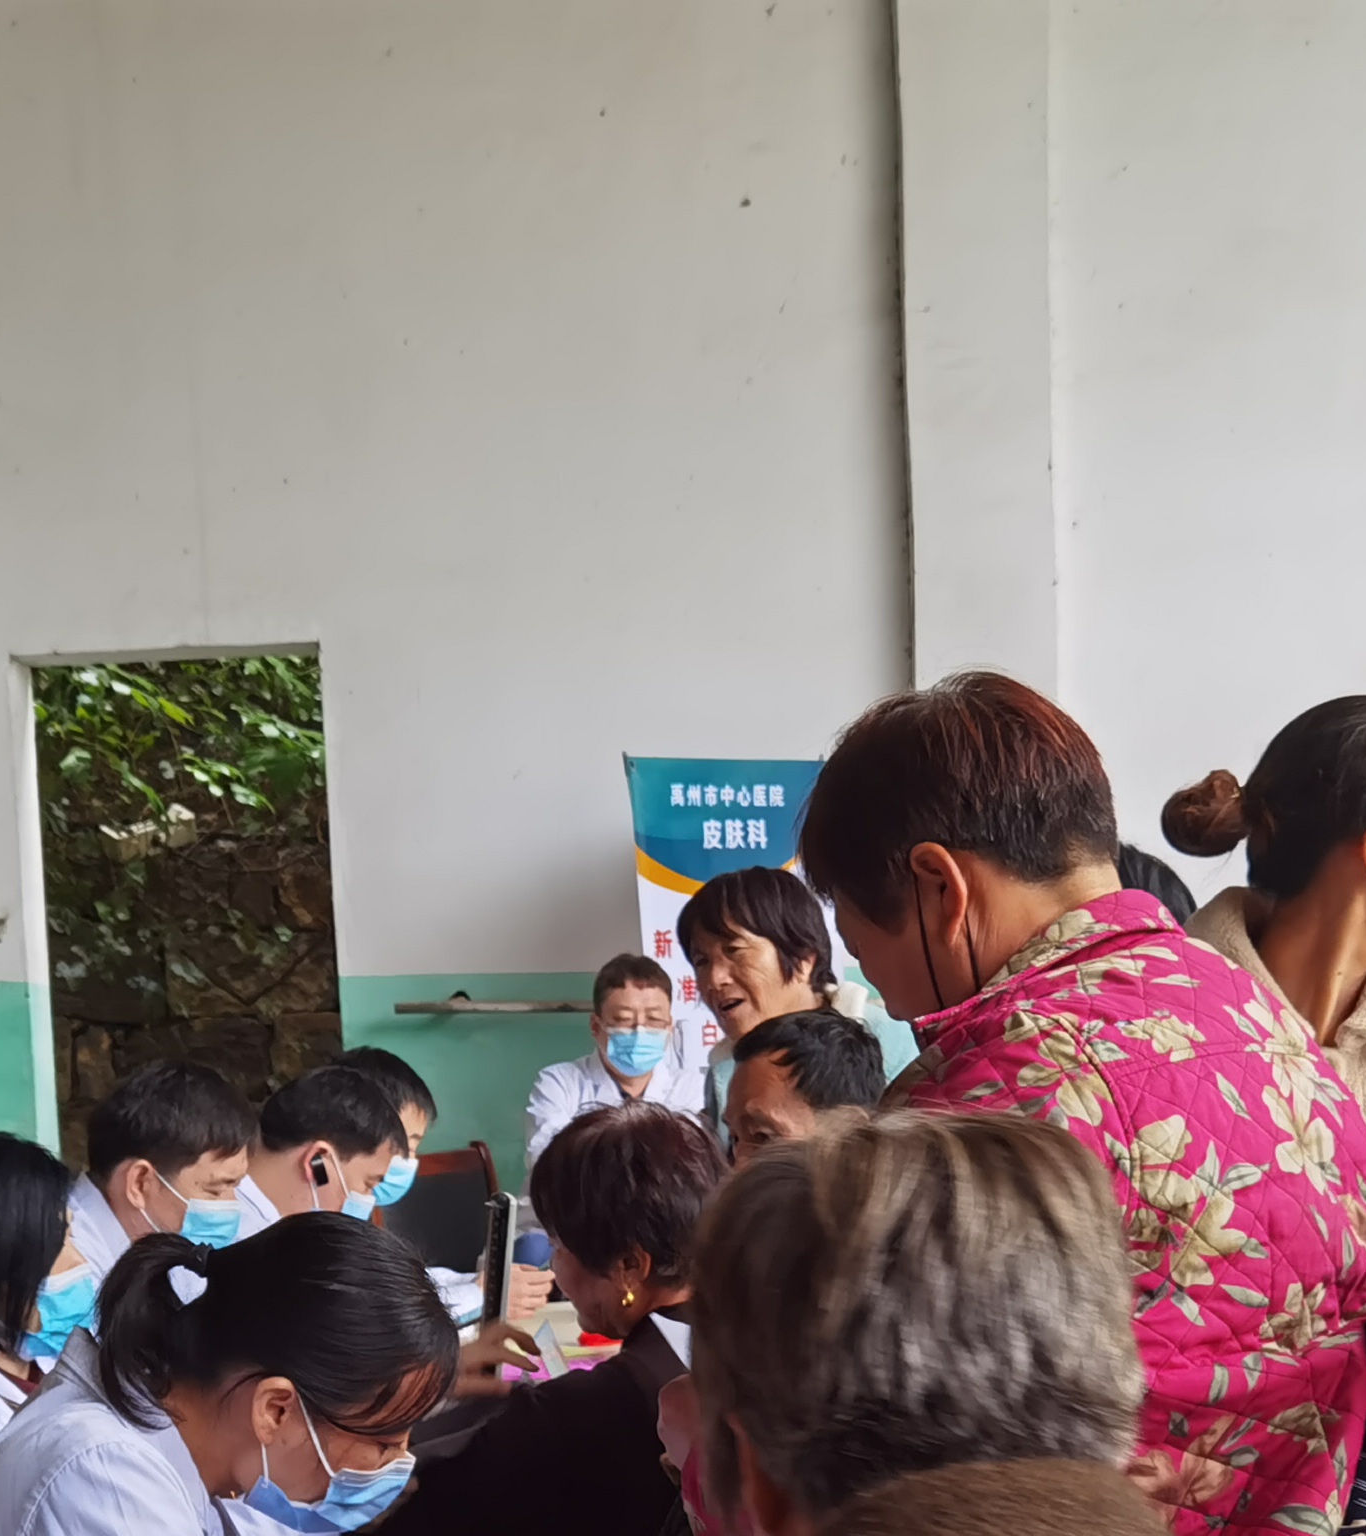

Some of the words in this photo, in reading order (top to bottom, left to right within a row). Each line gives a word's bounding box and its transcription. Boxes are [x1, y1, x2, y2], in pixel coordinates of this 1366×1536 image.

[669, 783, 785, 808] 禹州市中心医院
[702, 818, 768, 850] 皮肤科
